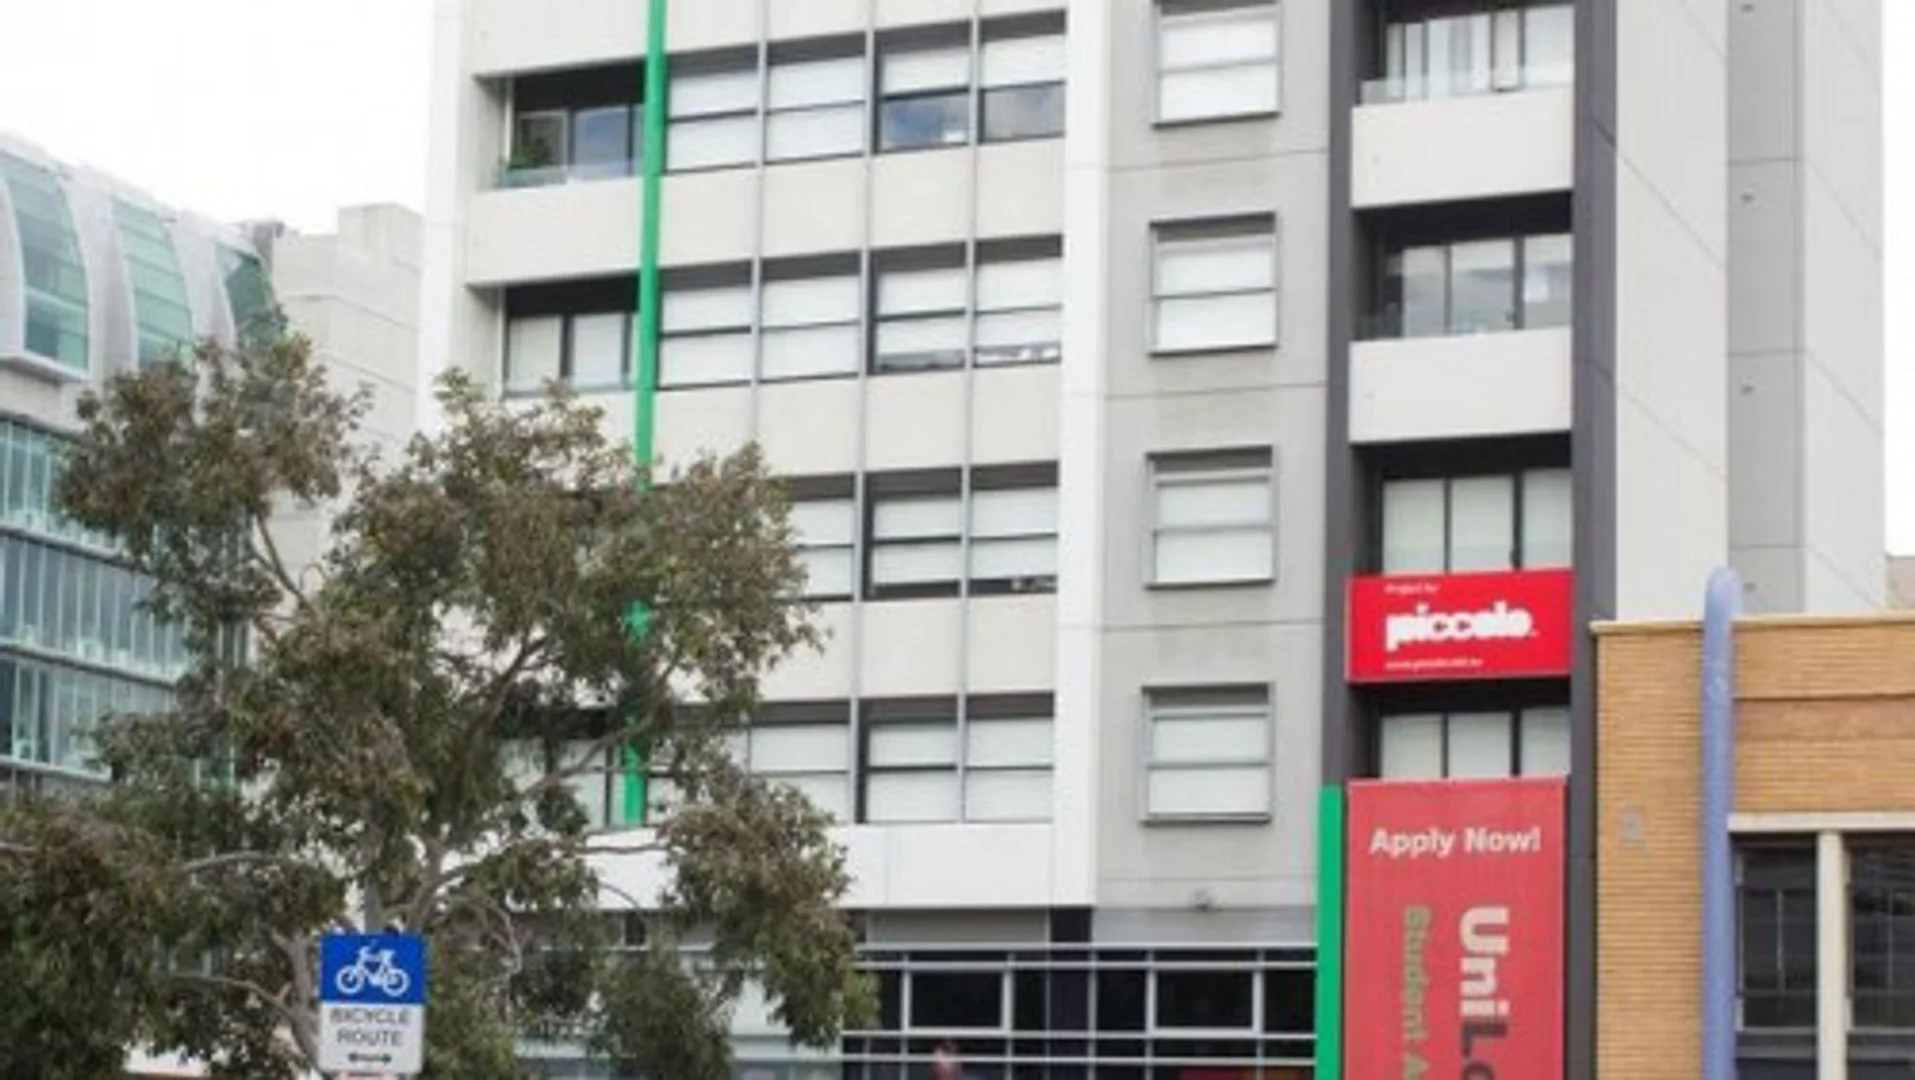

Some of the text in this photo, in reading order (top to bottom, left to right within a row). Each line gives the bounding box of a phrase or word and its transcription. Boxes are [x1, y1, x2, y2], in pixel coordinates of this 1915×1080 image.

[1369, 826, 1540, 859] Apply Now!
[1403, 906, 1432, 1040] Student
[329, 1006, 409, 1025] BICYCLE
[337, 1028, 402, 1046] ROUTE
